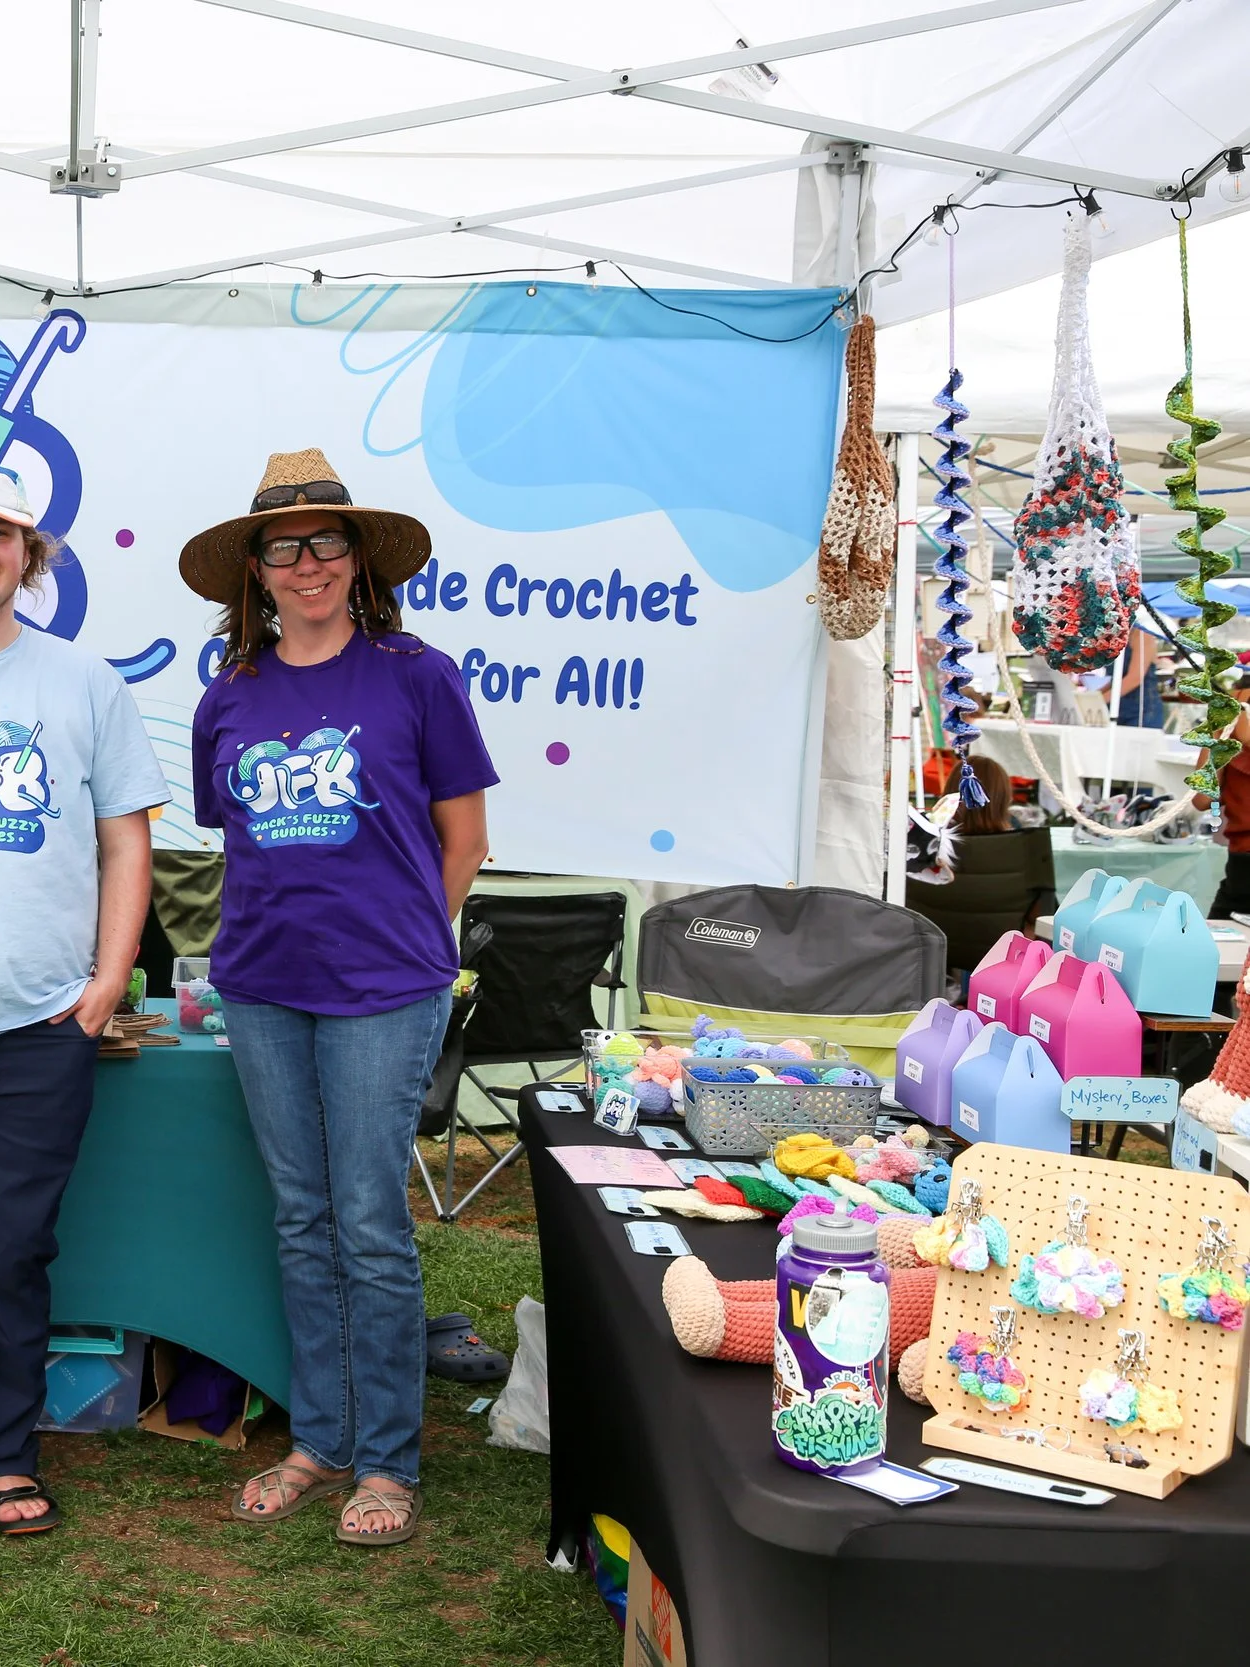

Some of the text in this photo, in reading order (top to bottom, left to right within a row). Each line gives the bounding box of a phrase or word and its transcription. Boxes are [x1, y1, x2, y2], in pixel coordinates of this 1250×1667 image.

[393, 557, 699, 626] de Crochet
[459, 647, 541, 703] for
[555, 655, 644, 710] All!
[241, 749, 357, 813] JFB
[251, 813, 351, 832] JACK'S FUZZY
[270, 826, 329, 840] BUDDIES
[693, 920, 744, 941] Coleman
[1070, 1088, 1168, 1106] Mystery Boxes
[782, 1349, 797, 1380] TOP
[822, 1372, 867, 1388] ARBOR
[791, 1400, 876, 1438] HAPPY
[793, 1426, 879, 1462] FISHING
[939, 1461, 1036, 1490] Keychains
